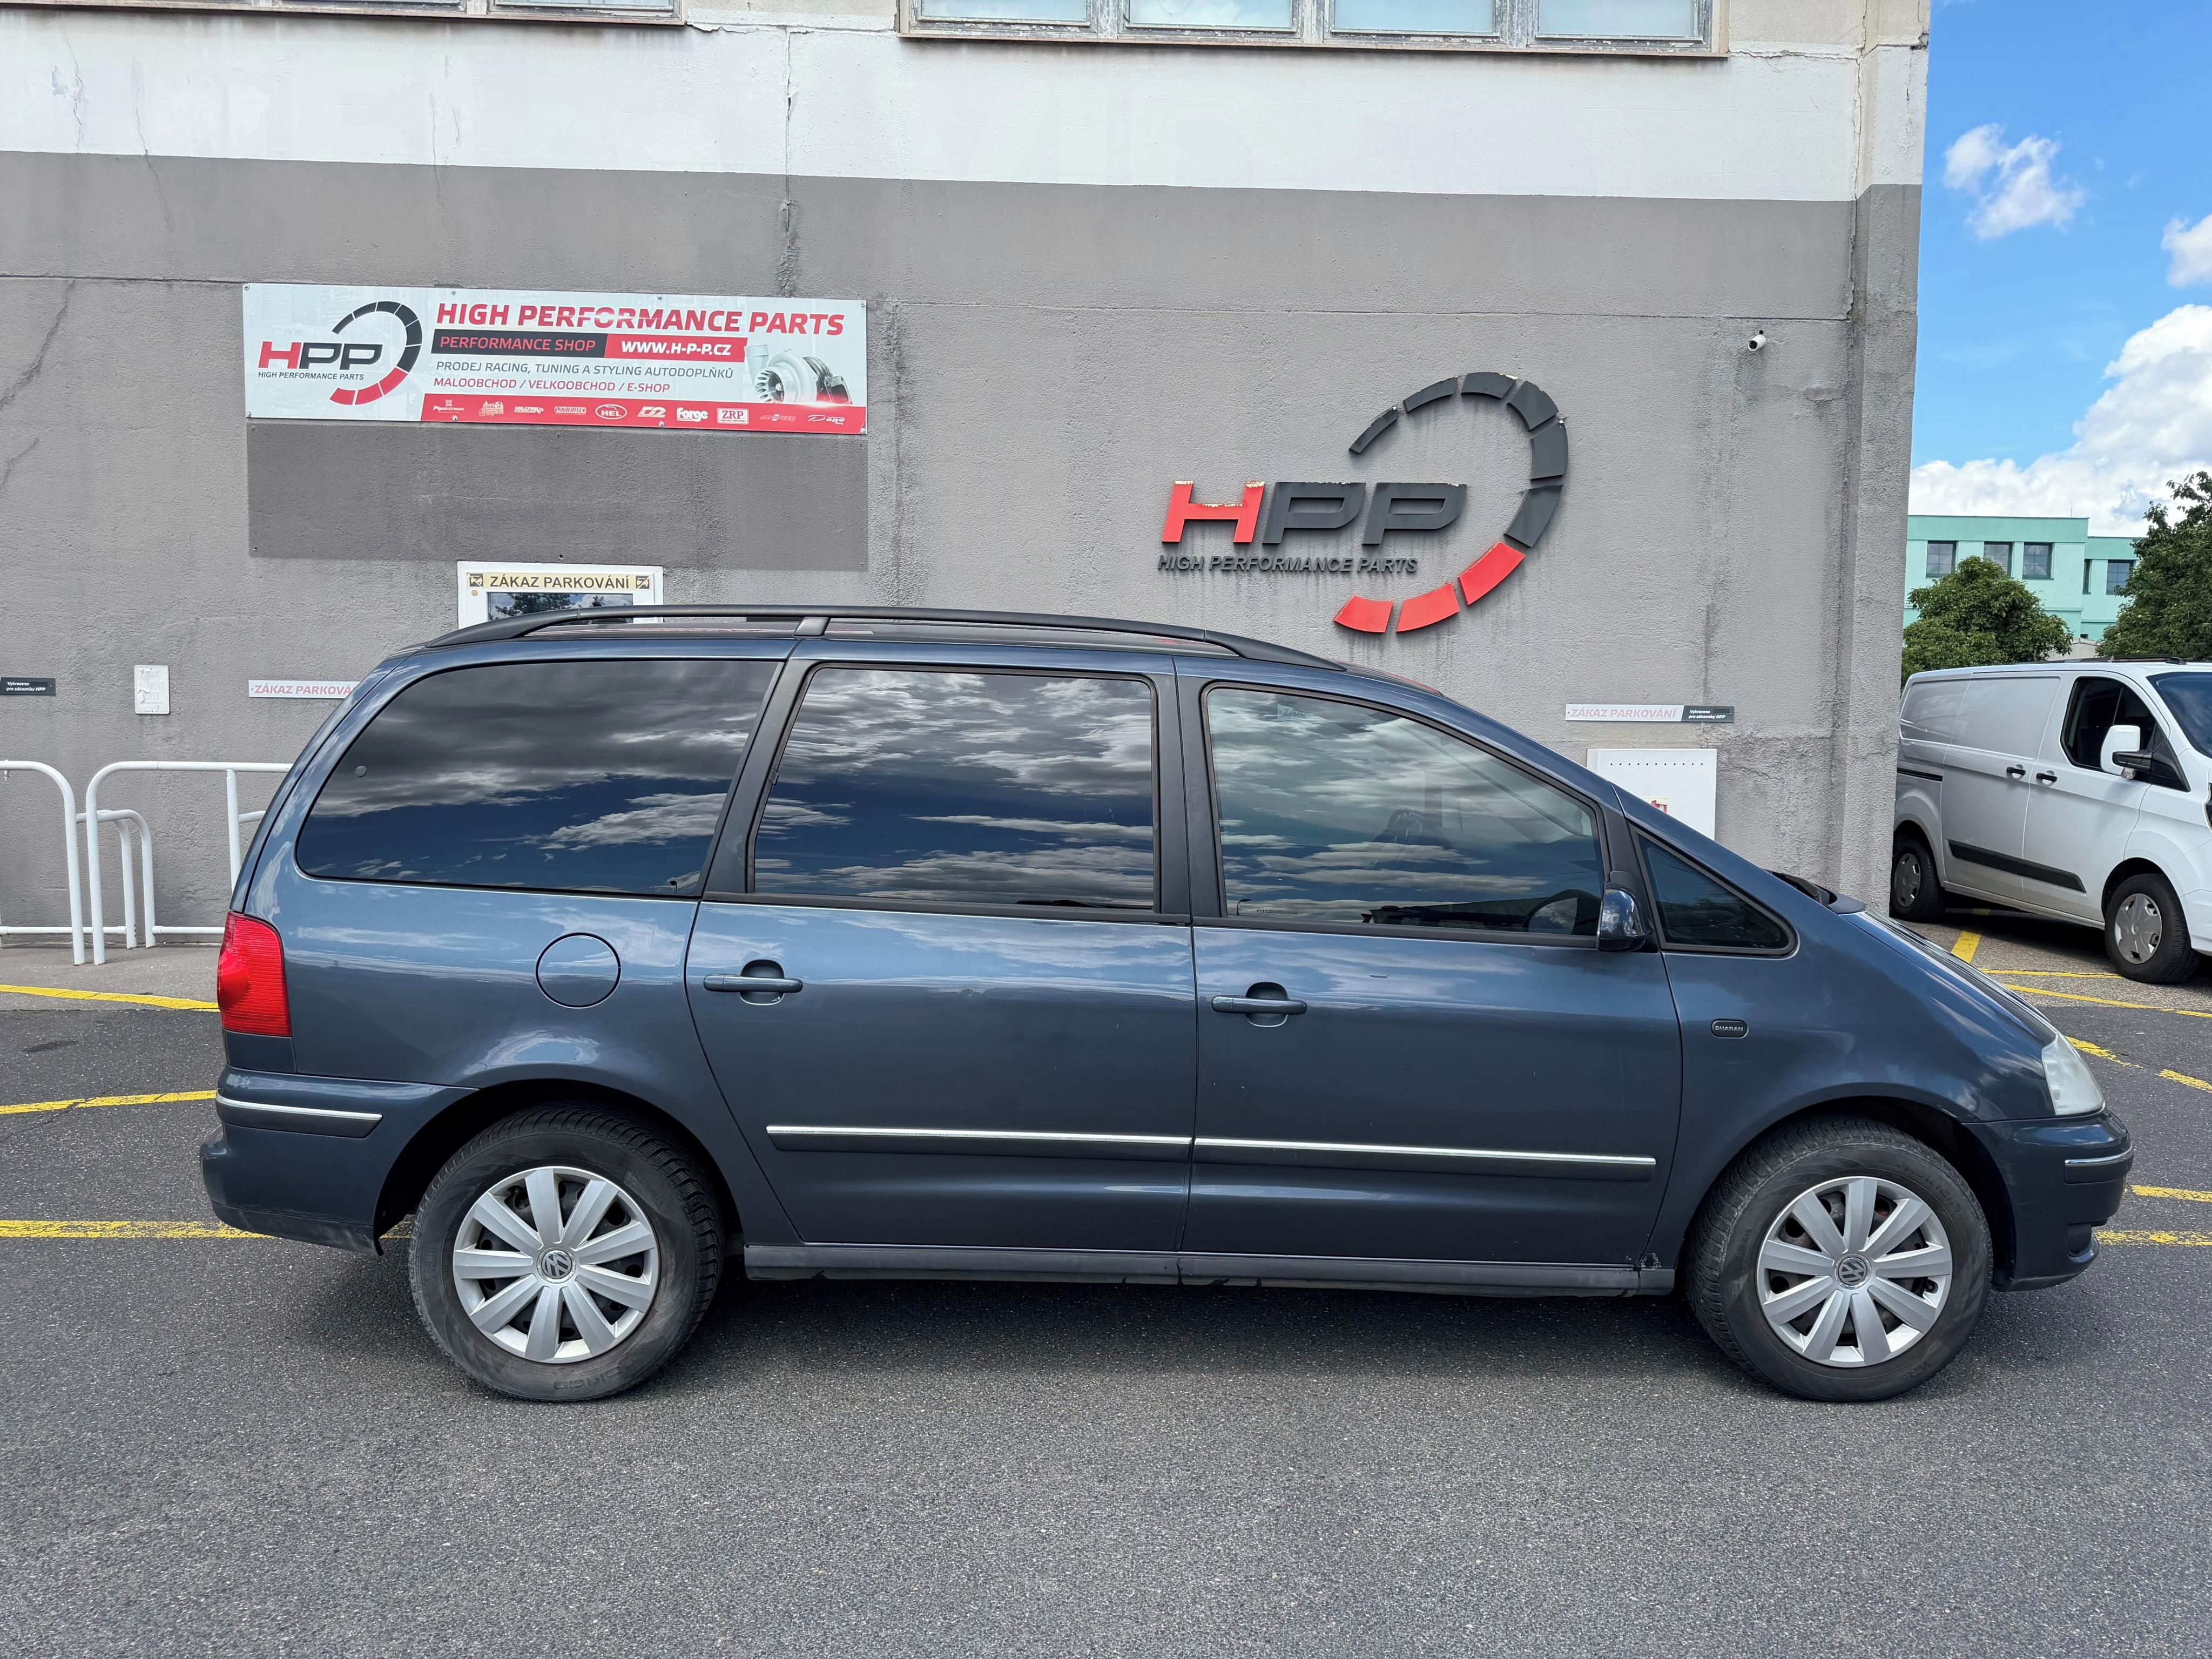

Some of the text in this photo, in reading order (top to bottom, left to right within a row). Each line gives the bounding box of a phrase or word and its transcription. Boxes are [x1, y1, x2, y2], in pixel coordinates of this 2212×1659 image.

[436, 303, 845, 336] HIGH PERFORMANCE PARTS
[440, 336, 596, 352] PERFORMANCE SHOP
[622, 341, 732, 356] WWW.H-P-P.CZ
[258, 341, 383, 370] HPP
[436, 361, 733, 379] PRODEJ RACING, TUNING A STYLING AUTODOPLŇKŮ
[434, 378, 517, 388] MALOOBCHOD
[529, 380, 615, 391] VELKOOBCHOD
[627, 382, 670, 393] E-SHOP
[721, 410, 744, 420] ZRP
[1162, 480, 1468, 545] HPP
[1158, 555, 1418, 574] HIGH PERFORMANCE PARTS
[490, 574, 630, 589] ZÁKAZ PARKOVÁNÍ
[254, 683, 355, 695] ZÁKAZ PARKOVÁ
[1570, 707, 1677, 718] ZÁKAZ PARKOVÁNÍ
